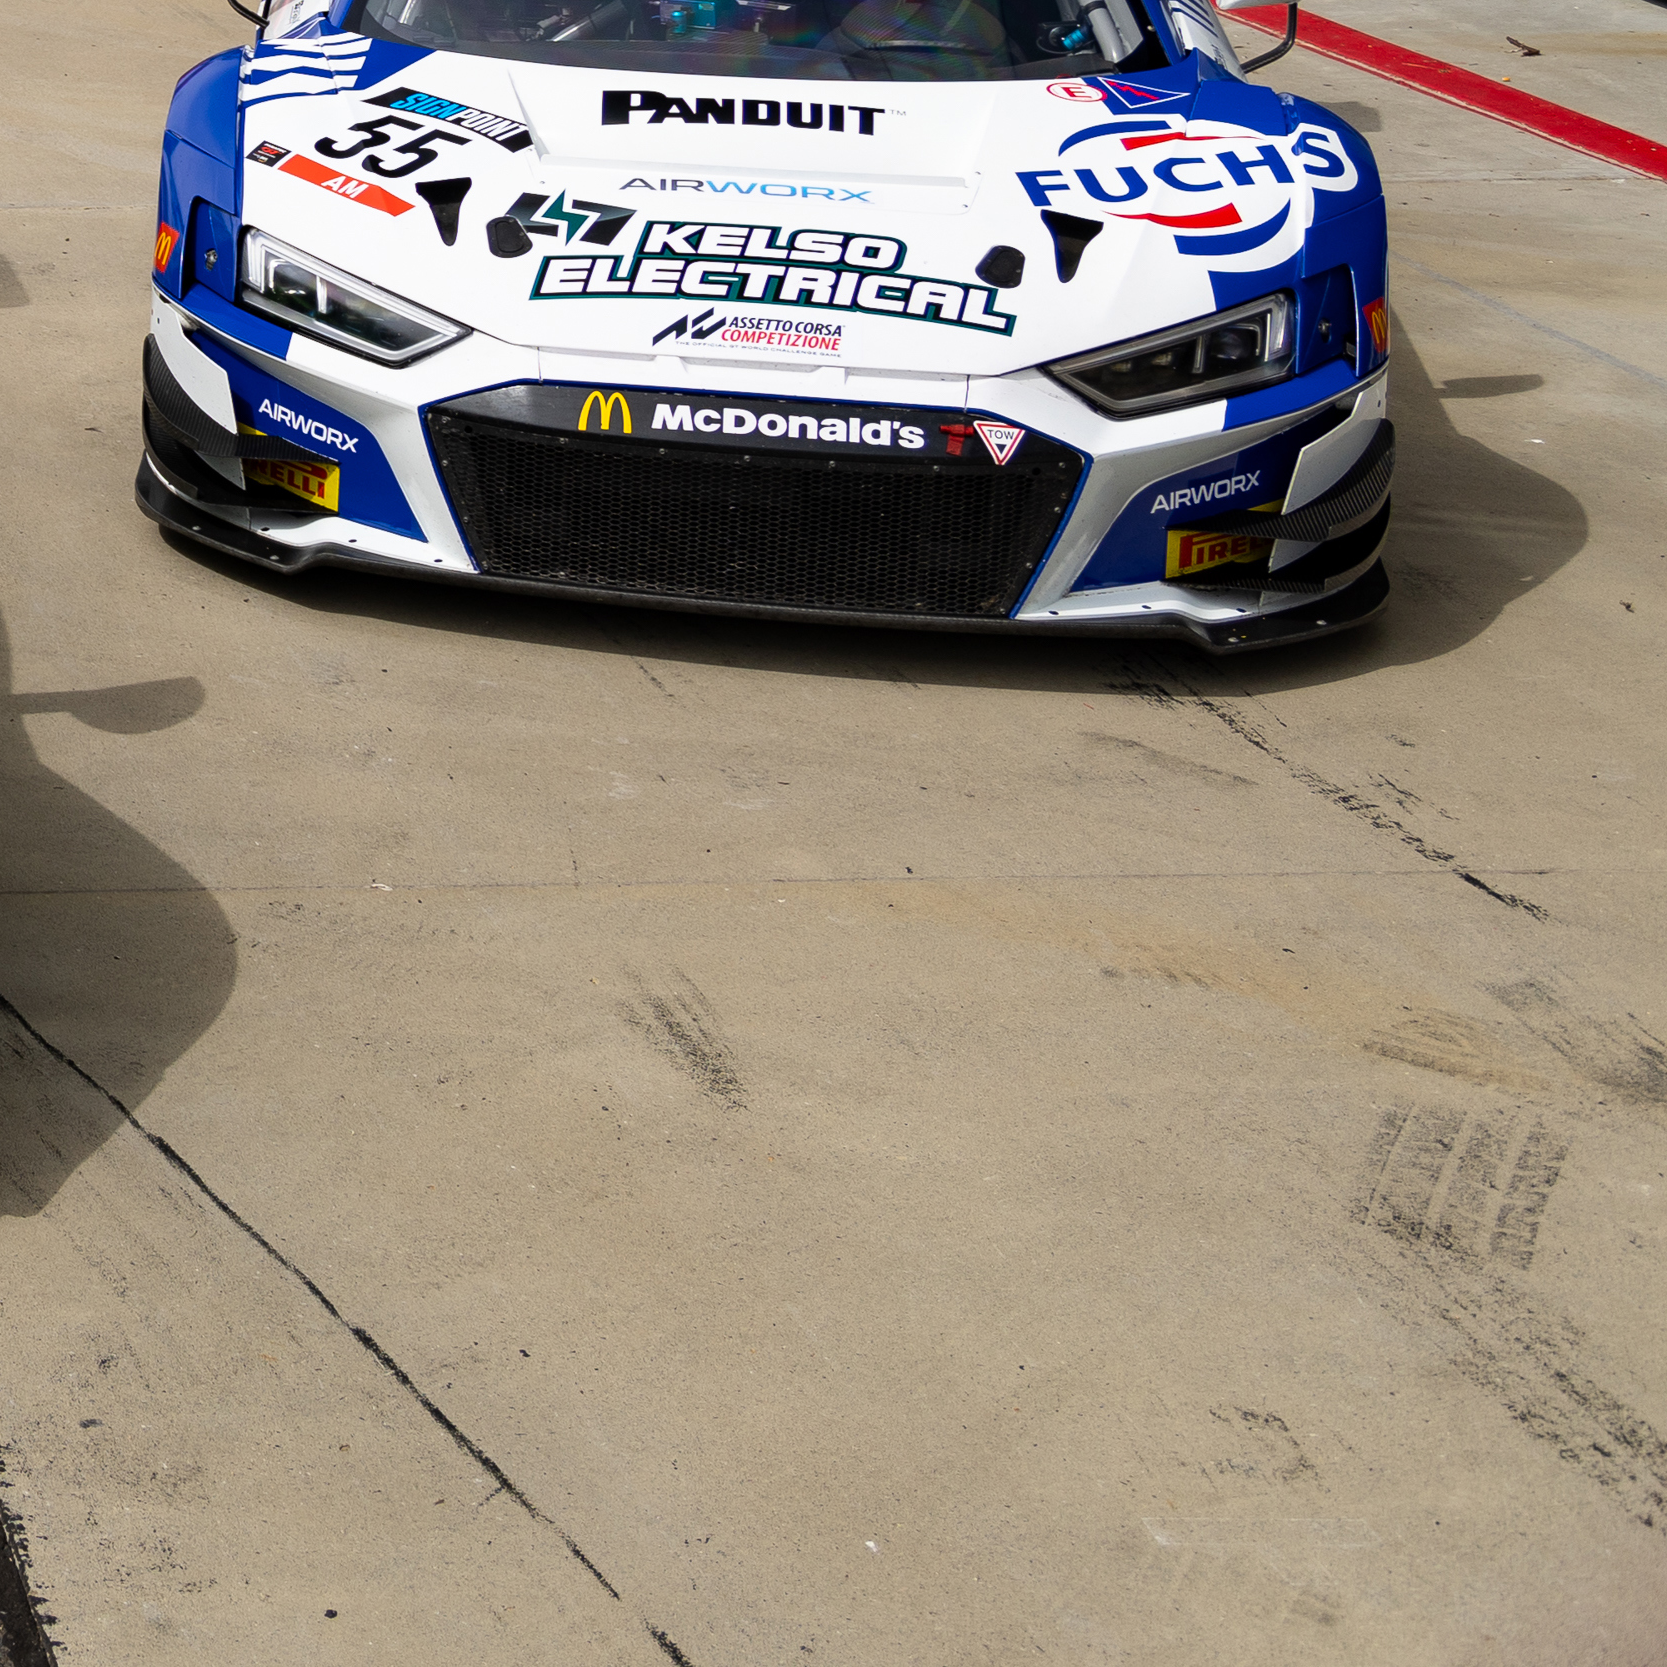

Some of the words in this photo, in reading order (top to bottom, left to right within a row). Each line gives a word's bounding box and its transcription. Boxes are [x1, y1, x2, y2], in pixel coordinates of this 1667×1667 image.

[390, 92, 528, 142] SIGNPOINT
[314, 114, 474, 179] 55
[1014, 130, 1346, 207] FUCHS
[320, 175, 369, 199] AM
[619, 177, 874, 204] AIRWORX
[642, 222, 901, 269] KELSO
[538, 256, 1011, 331] ELECTRICAL
[720, 328, 842, 352] COMPETIZIONE
[728, 316, 793, 333] ASSETTO
[794, 320, 843, 338] CORSA
[740, 344, 770, 352] WORLD
[771, 346, 818, 356] CHALLENGE
[258, 397, 360, 454] AIRWORX
[650, 401, 926, 452] McDonald's
[987, 429, 1015, 440] TOW
[1149, 470, 1261, 515] AIRWORX
